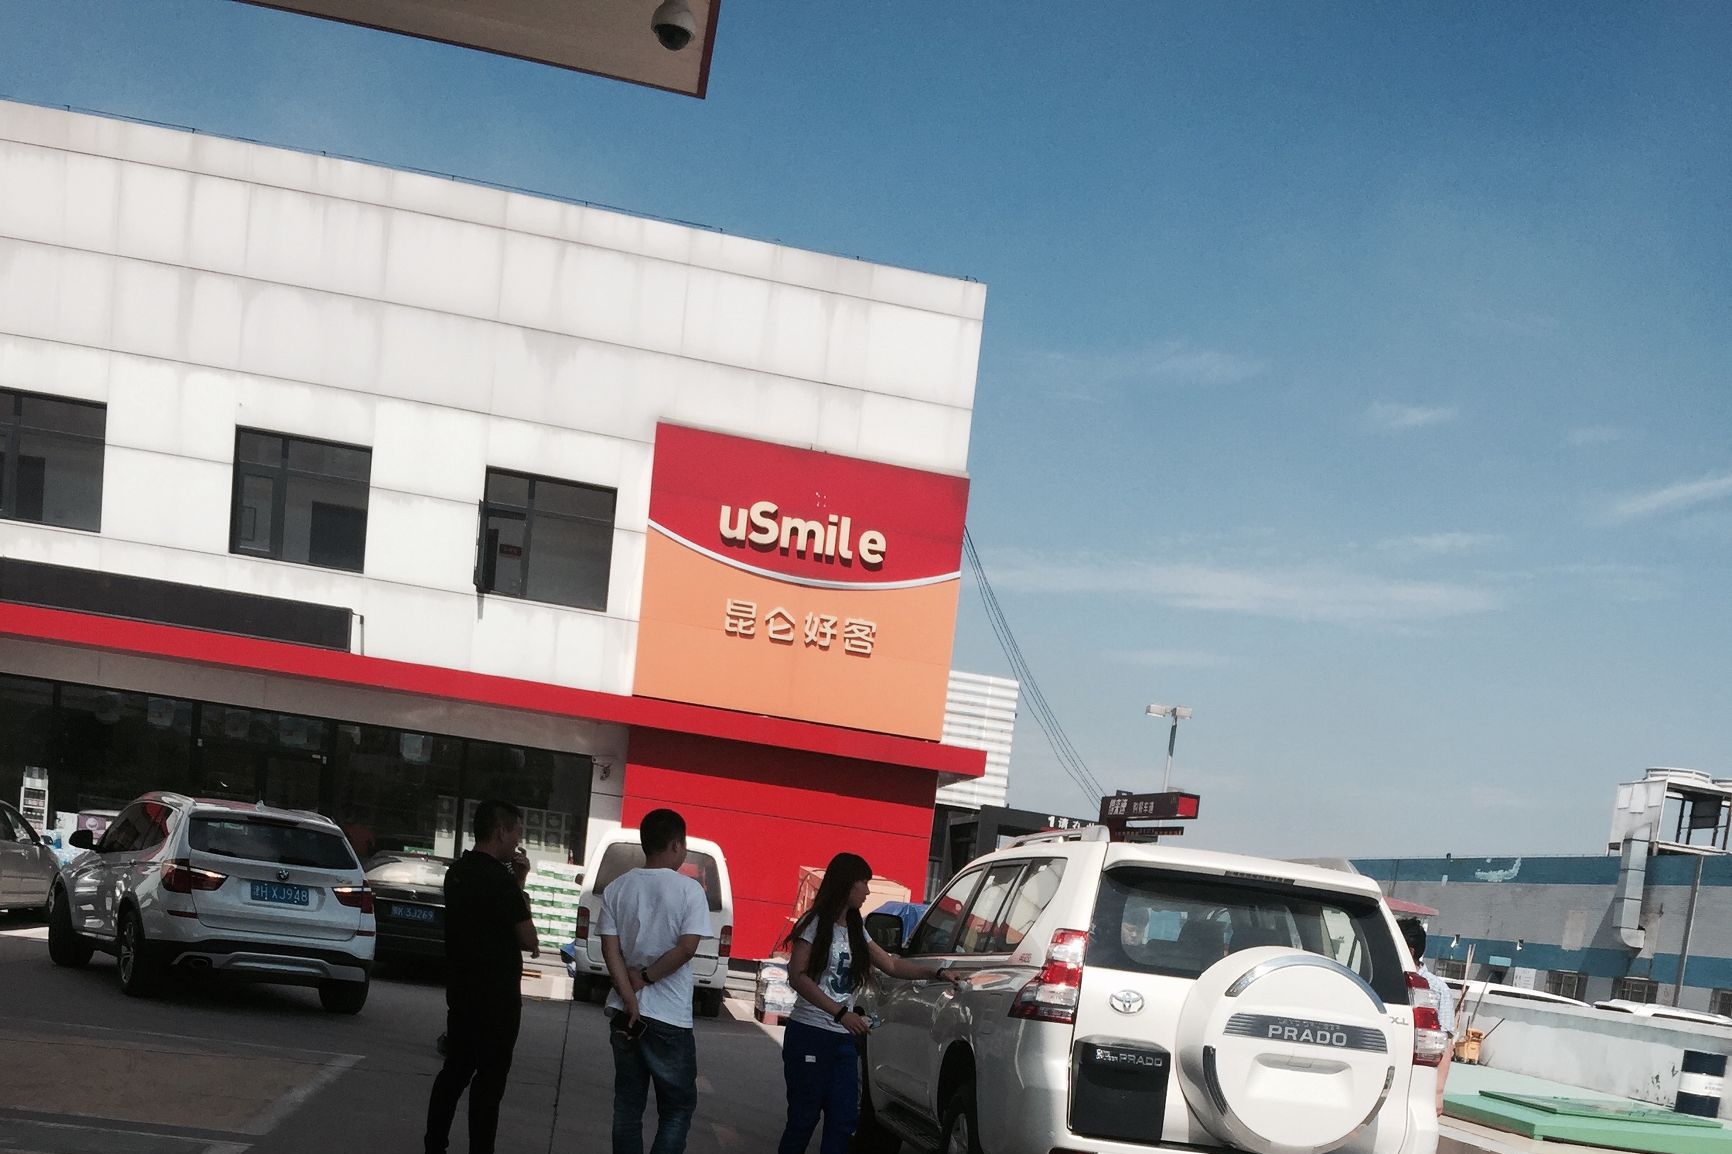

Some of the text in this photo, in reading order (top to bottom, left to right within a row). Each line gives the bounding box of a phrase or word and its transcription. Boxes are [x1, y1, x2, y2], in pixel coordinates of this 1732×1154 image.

[719, 501, 887, 565] uSmile
[724, 598, 878, 656] 昆仑好客
[1267, 1024, 1347, 1046] PRADO
[1118, 1053, 1163, 1067] PRADO
